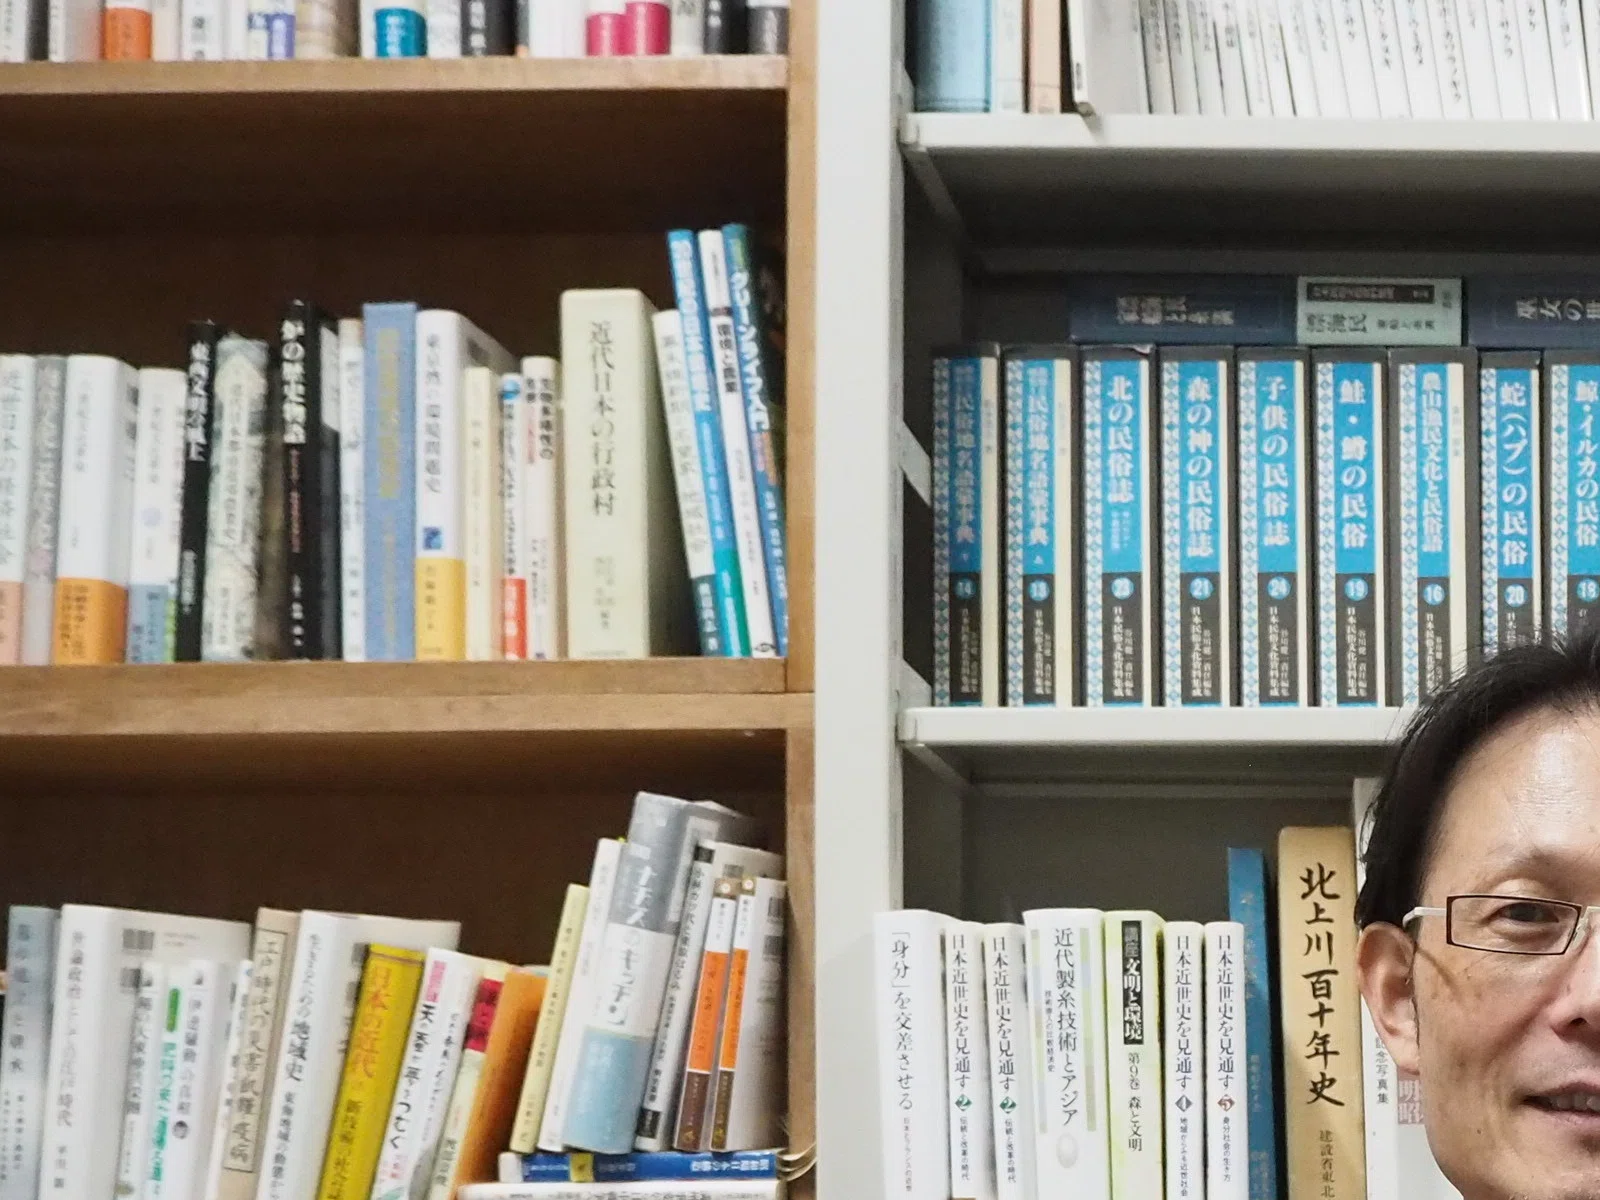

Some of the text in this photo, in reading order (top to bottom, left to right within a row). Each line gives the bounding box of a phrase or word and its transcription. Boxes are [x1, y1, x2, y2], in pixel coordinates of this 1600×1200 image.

[1107, 375, 1135, 504] 北の民俗誌
[1186, 375, 1214, 558] 森の神の民俗誌
[1261, 375, 1291, 547] 子供の民俗誌
[1574, 379, 1600, 547] 鯨・イルカの民俗
[890, 932, 914, 1111] 「身分」を交差させる
[951, 934, 972, 1090] 日本近世史を見通す
[992, 936, 1016, 1092] 日本近世史を見通す
[1053, 927, 1079, 1128] 近代製糸技術とアジア
[1174, 934, 1193, 1090] 日本近世史を見通す
[1217, 934, 1235, 1090] 日本近世史を見通す
[1299, 862, 1345, 1107] 北上川百十年史
[1128, 1095, 1142, 1152] 森と文明
